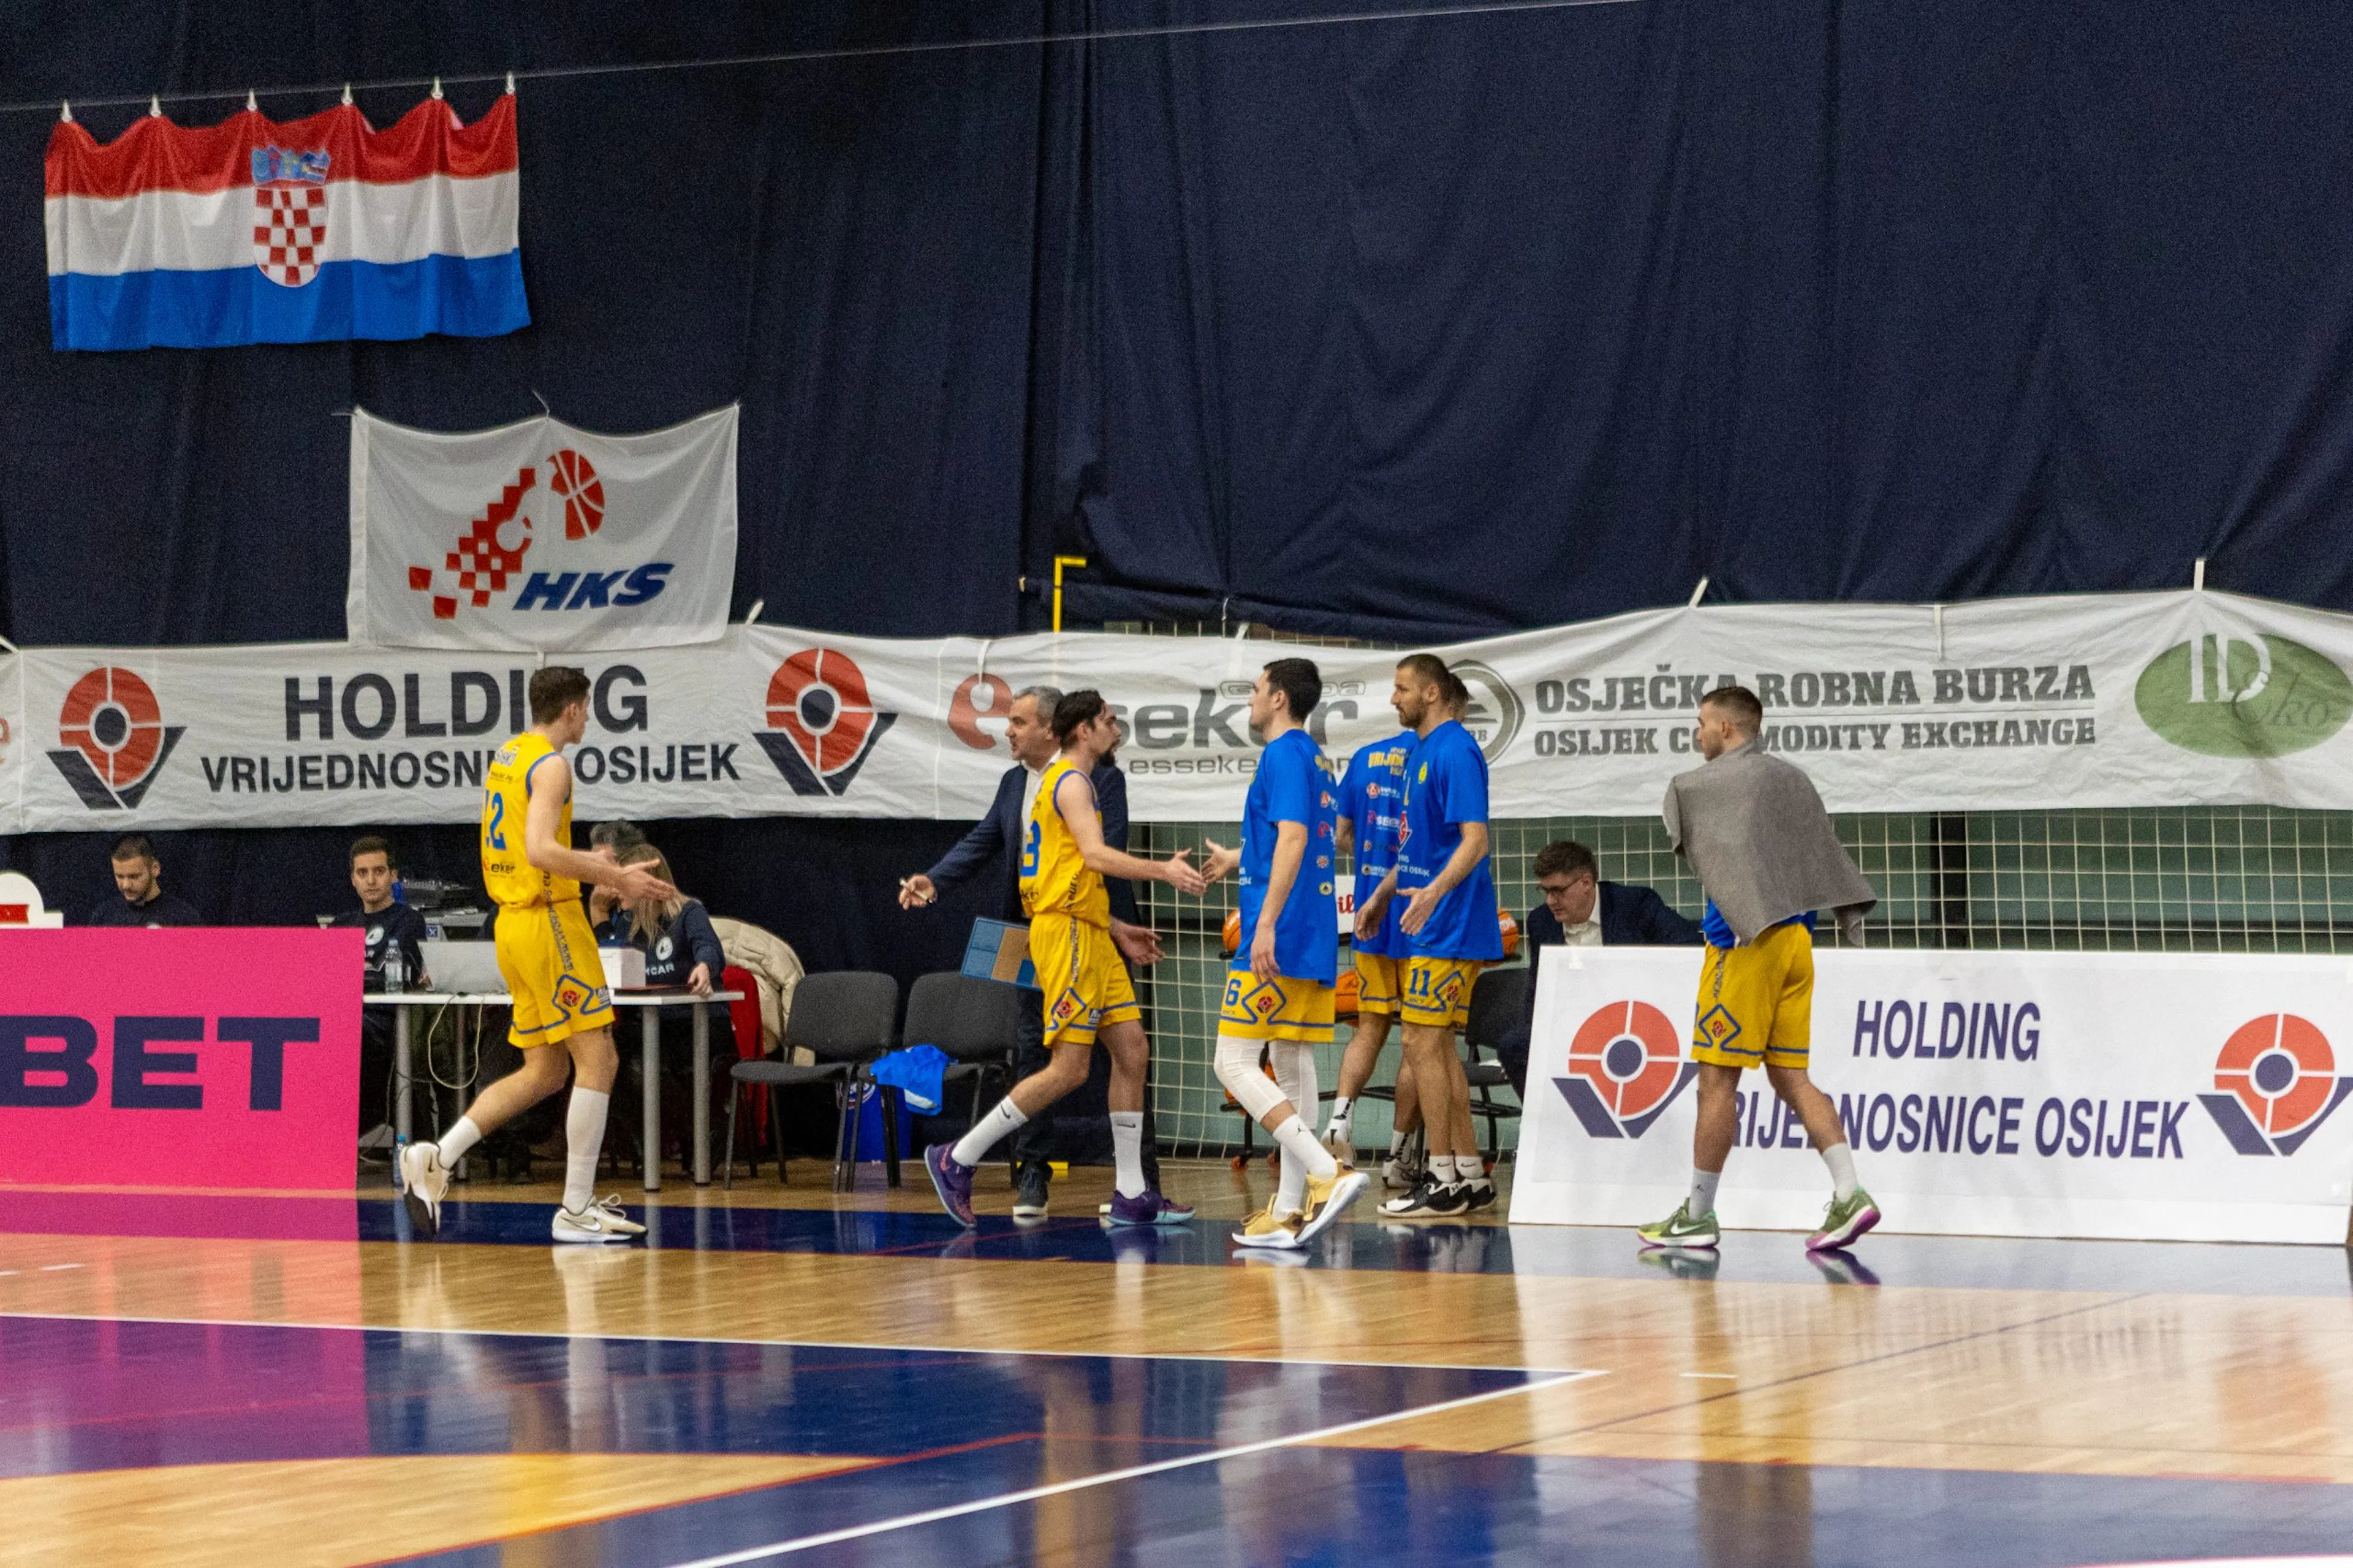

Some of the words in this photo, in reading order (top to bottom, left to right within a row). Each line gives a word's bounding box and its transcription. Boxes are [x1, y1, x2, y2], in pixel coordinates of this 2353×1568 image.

[512, 562, 675, 611] HKS
[285, 665, 648, 741] HOLDIG
[1756, 671, 1920, 708] ROBNA
[1932, 665, 2096, 705] BURZA
[1534, 728, 1659, 757] OSIJEK
[1901, 718, 2096, 749] EXCHANGE
[574, 743, 741, 784] OSIJEK
[1225, 979, 1242, 1007] 6
[1409, 968, 1431, 998] 11
[1853, 999, 2040, 1062] HOLDING
[0, 1015, 320, 1111] BET
[2035, 1097, 2189, 1159] OSIJEK
